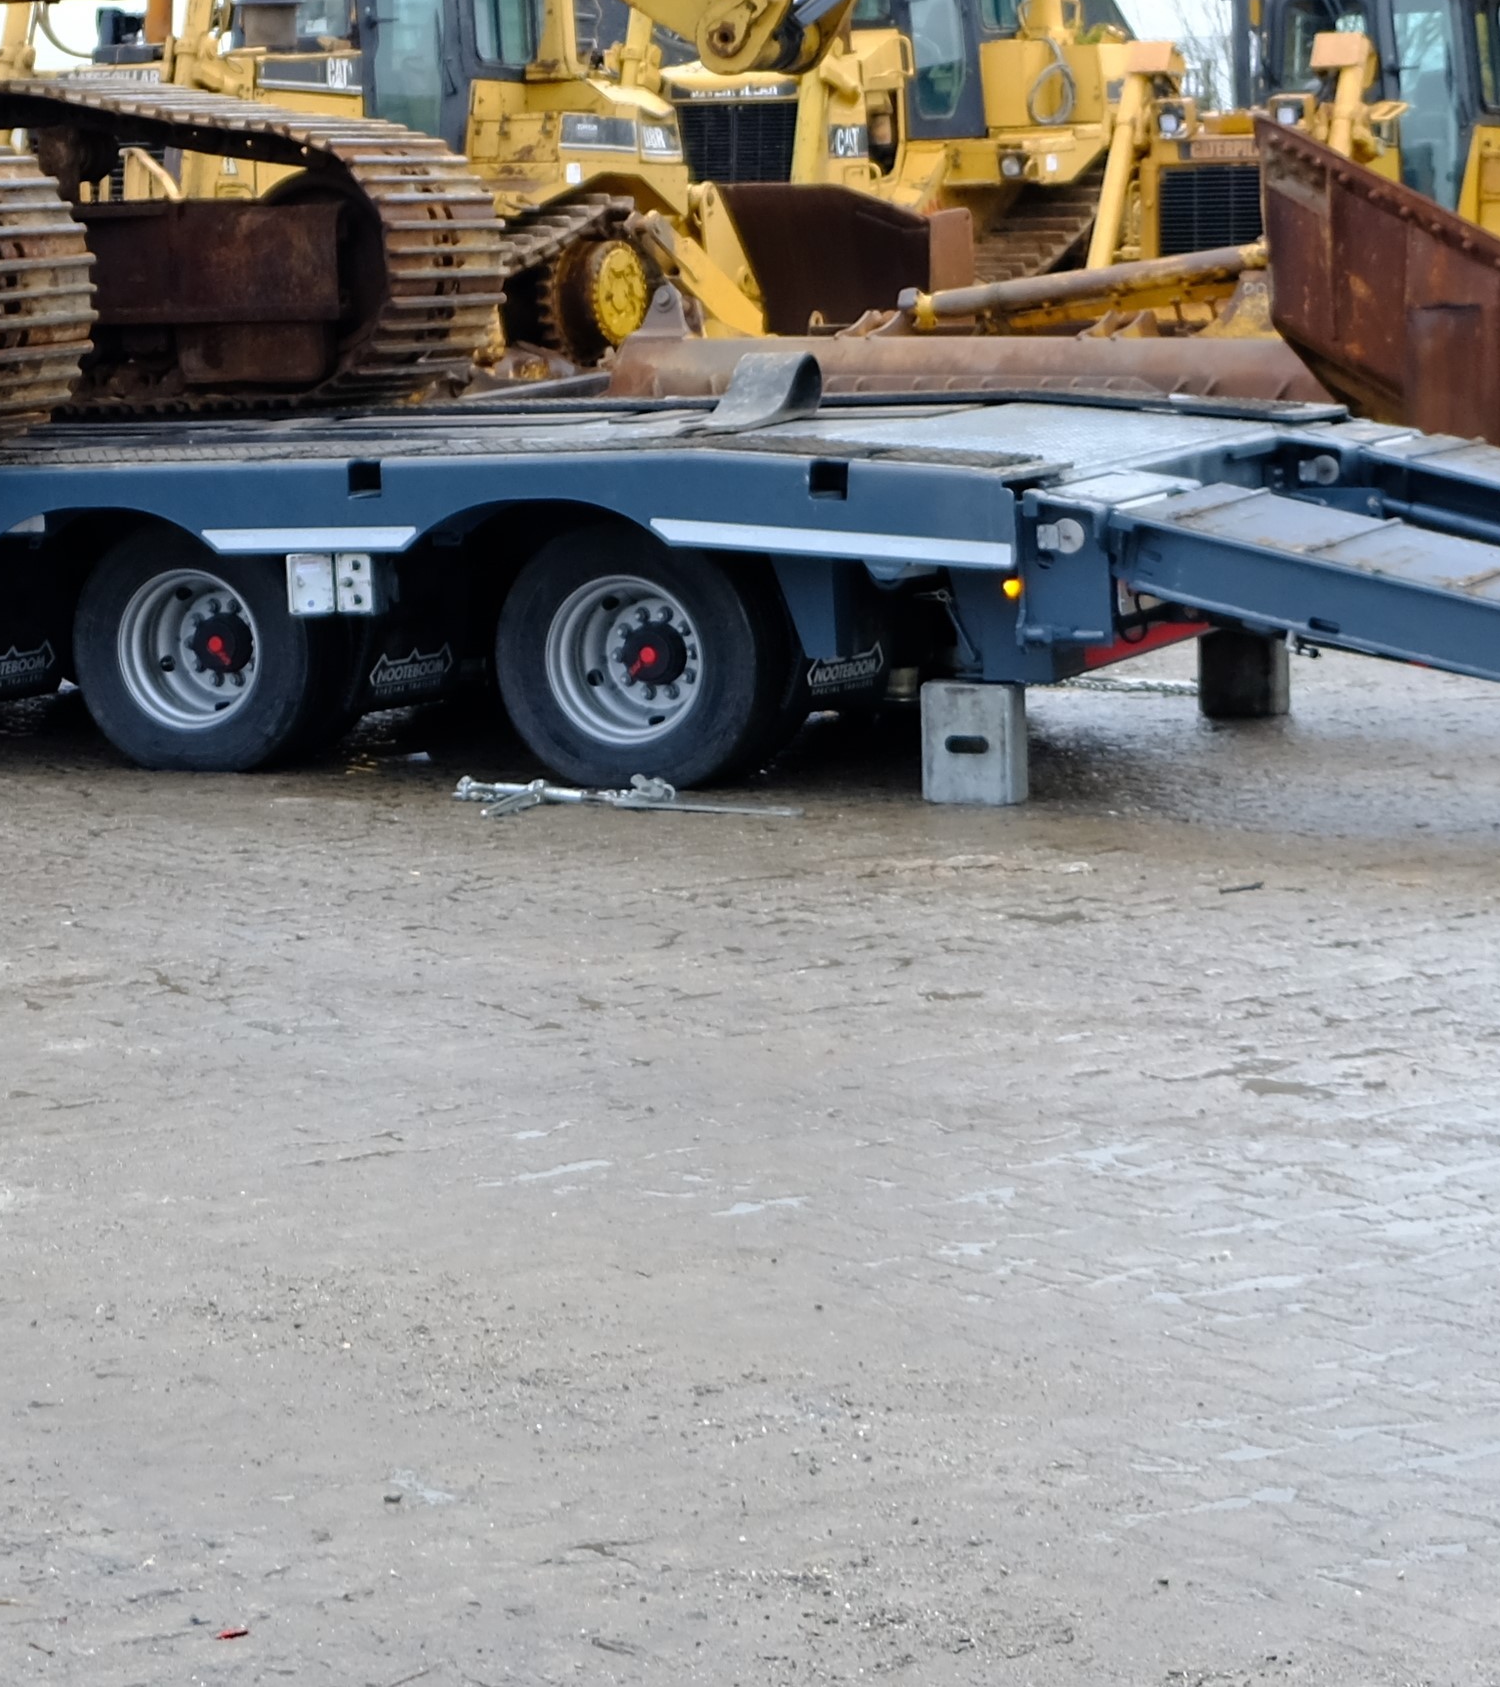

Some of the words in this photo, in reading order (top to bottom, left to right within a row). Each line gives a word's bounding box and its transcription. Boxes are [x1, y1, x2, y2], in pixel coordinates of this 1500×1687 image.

[326, 57, 349, 89] CAT
[835, 127, 861, 157] CAT
[376, 658, 445, 684] NOOTEBOOM
[813, 658, 877, 683] NOOTEBOOM
